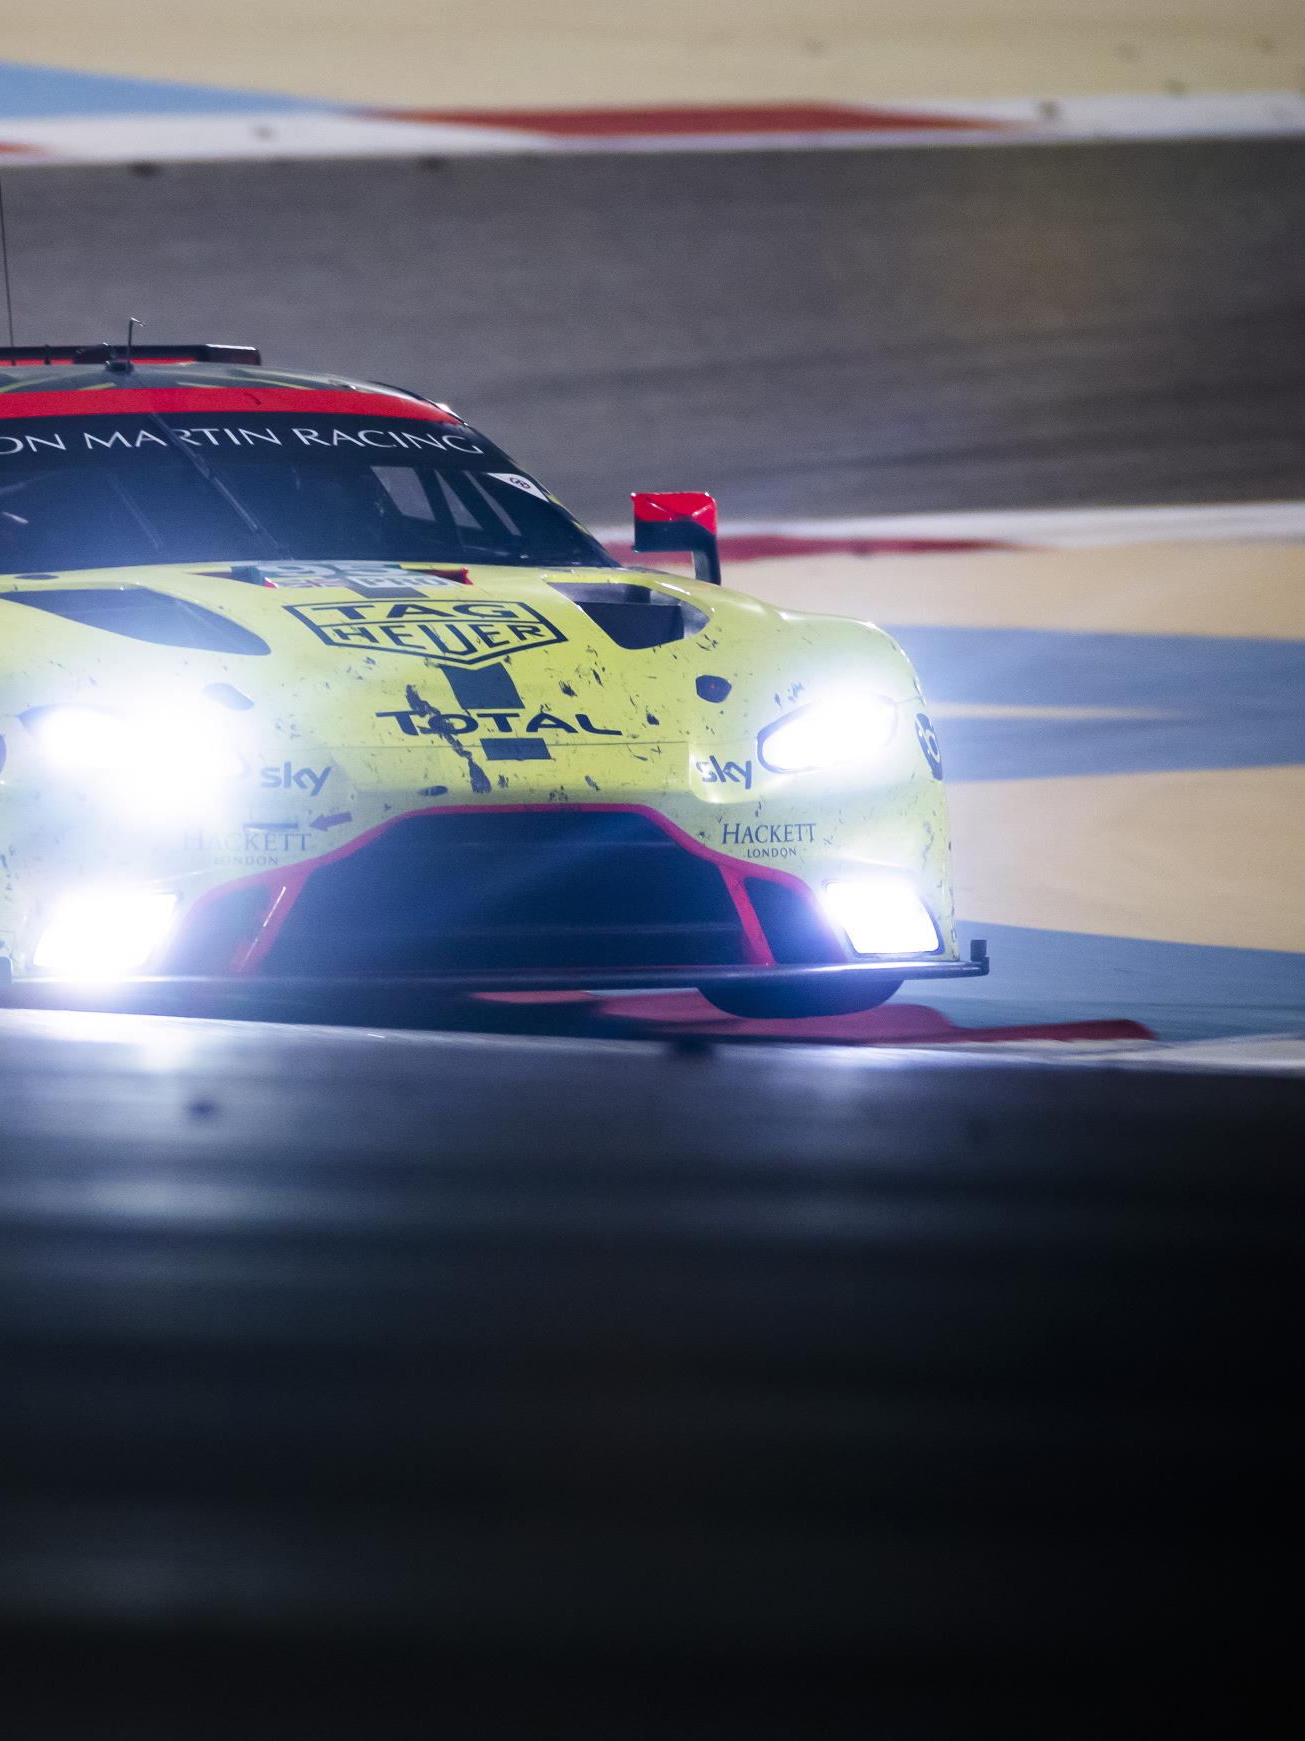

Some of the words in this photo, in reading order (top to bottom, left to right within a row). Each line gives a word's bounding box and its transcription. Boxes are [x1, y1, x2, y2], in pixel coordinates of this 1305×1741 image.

[83, 428, 283, 450] MARTIN
[291, 427, 485, 455] RACING
[311, 603, 519, 620] TAG
[332, 622, 546, 656] HEUER
[376, 710, 623, 736] TOTAL
[260, 761, 332, 797] sky
[695, 755, 753, 790] sky
[183, 829, 313, 852] HACKETT
[721, 822, 817, 846] HACKETT
[746, 847, 797, 859] LONDON
